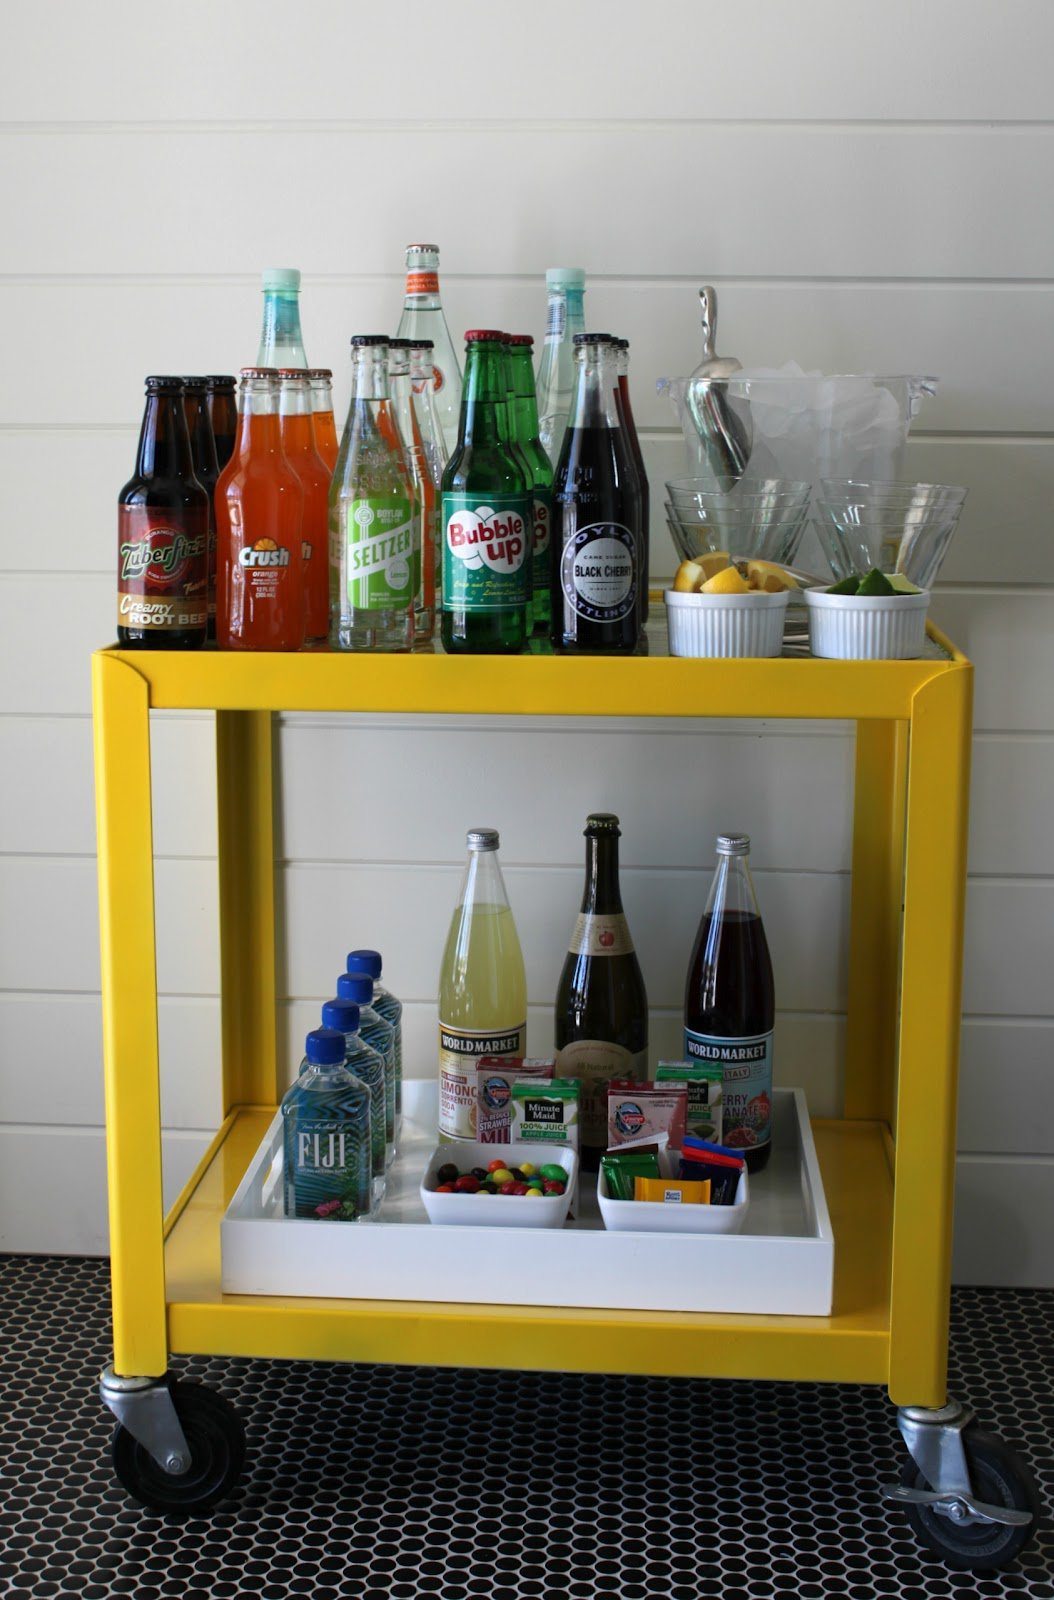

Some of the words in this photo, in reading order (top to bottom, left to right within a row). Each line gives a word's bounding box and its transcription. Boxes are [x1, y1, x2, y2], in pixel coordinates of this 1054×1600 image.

[449, 516, 522, 547] Bubble
[239, 546, 289, 566] Crush
[353, 529, 410, 570] SELTZER
[487, 537, 522, 565] up
[575, 565, 602, 577] BLACK
[604, 565, 632, 577] CHERRY
[120, 596, 174, 615] Creamy
[129, 614, 175, 625] ROOT
[178, 613, 206, 624] BEE
[441, 1034, 474, 1052] WORLD
[474, 1037, 518, 1053] MARKET
[687, 1041, 720, 1059] WORLD
[720, 1044, 765, 1060] MARKET
[528, 1103, 560, 1113] Minute
[722, 1094, 748, 1106] ERRY
[479, 1116, 511, 1132] STRAWBE
[533, 1112, 556, 1120] Maid
[480, 1129, 511, 1144] MIL
[544, 1124, 568, 1132] JUICE
[297, 1132, 346, 1168] FIJI
